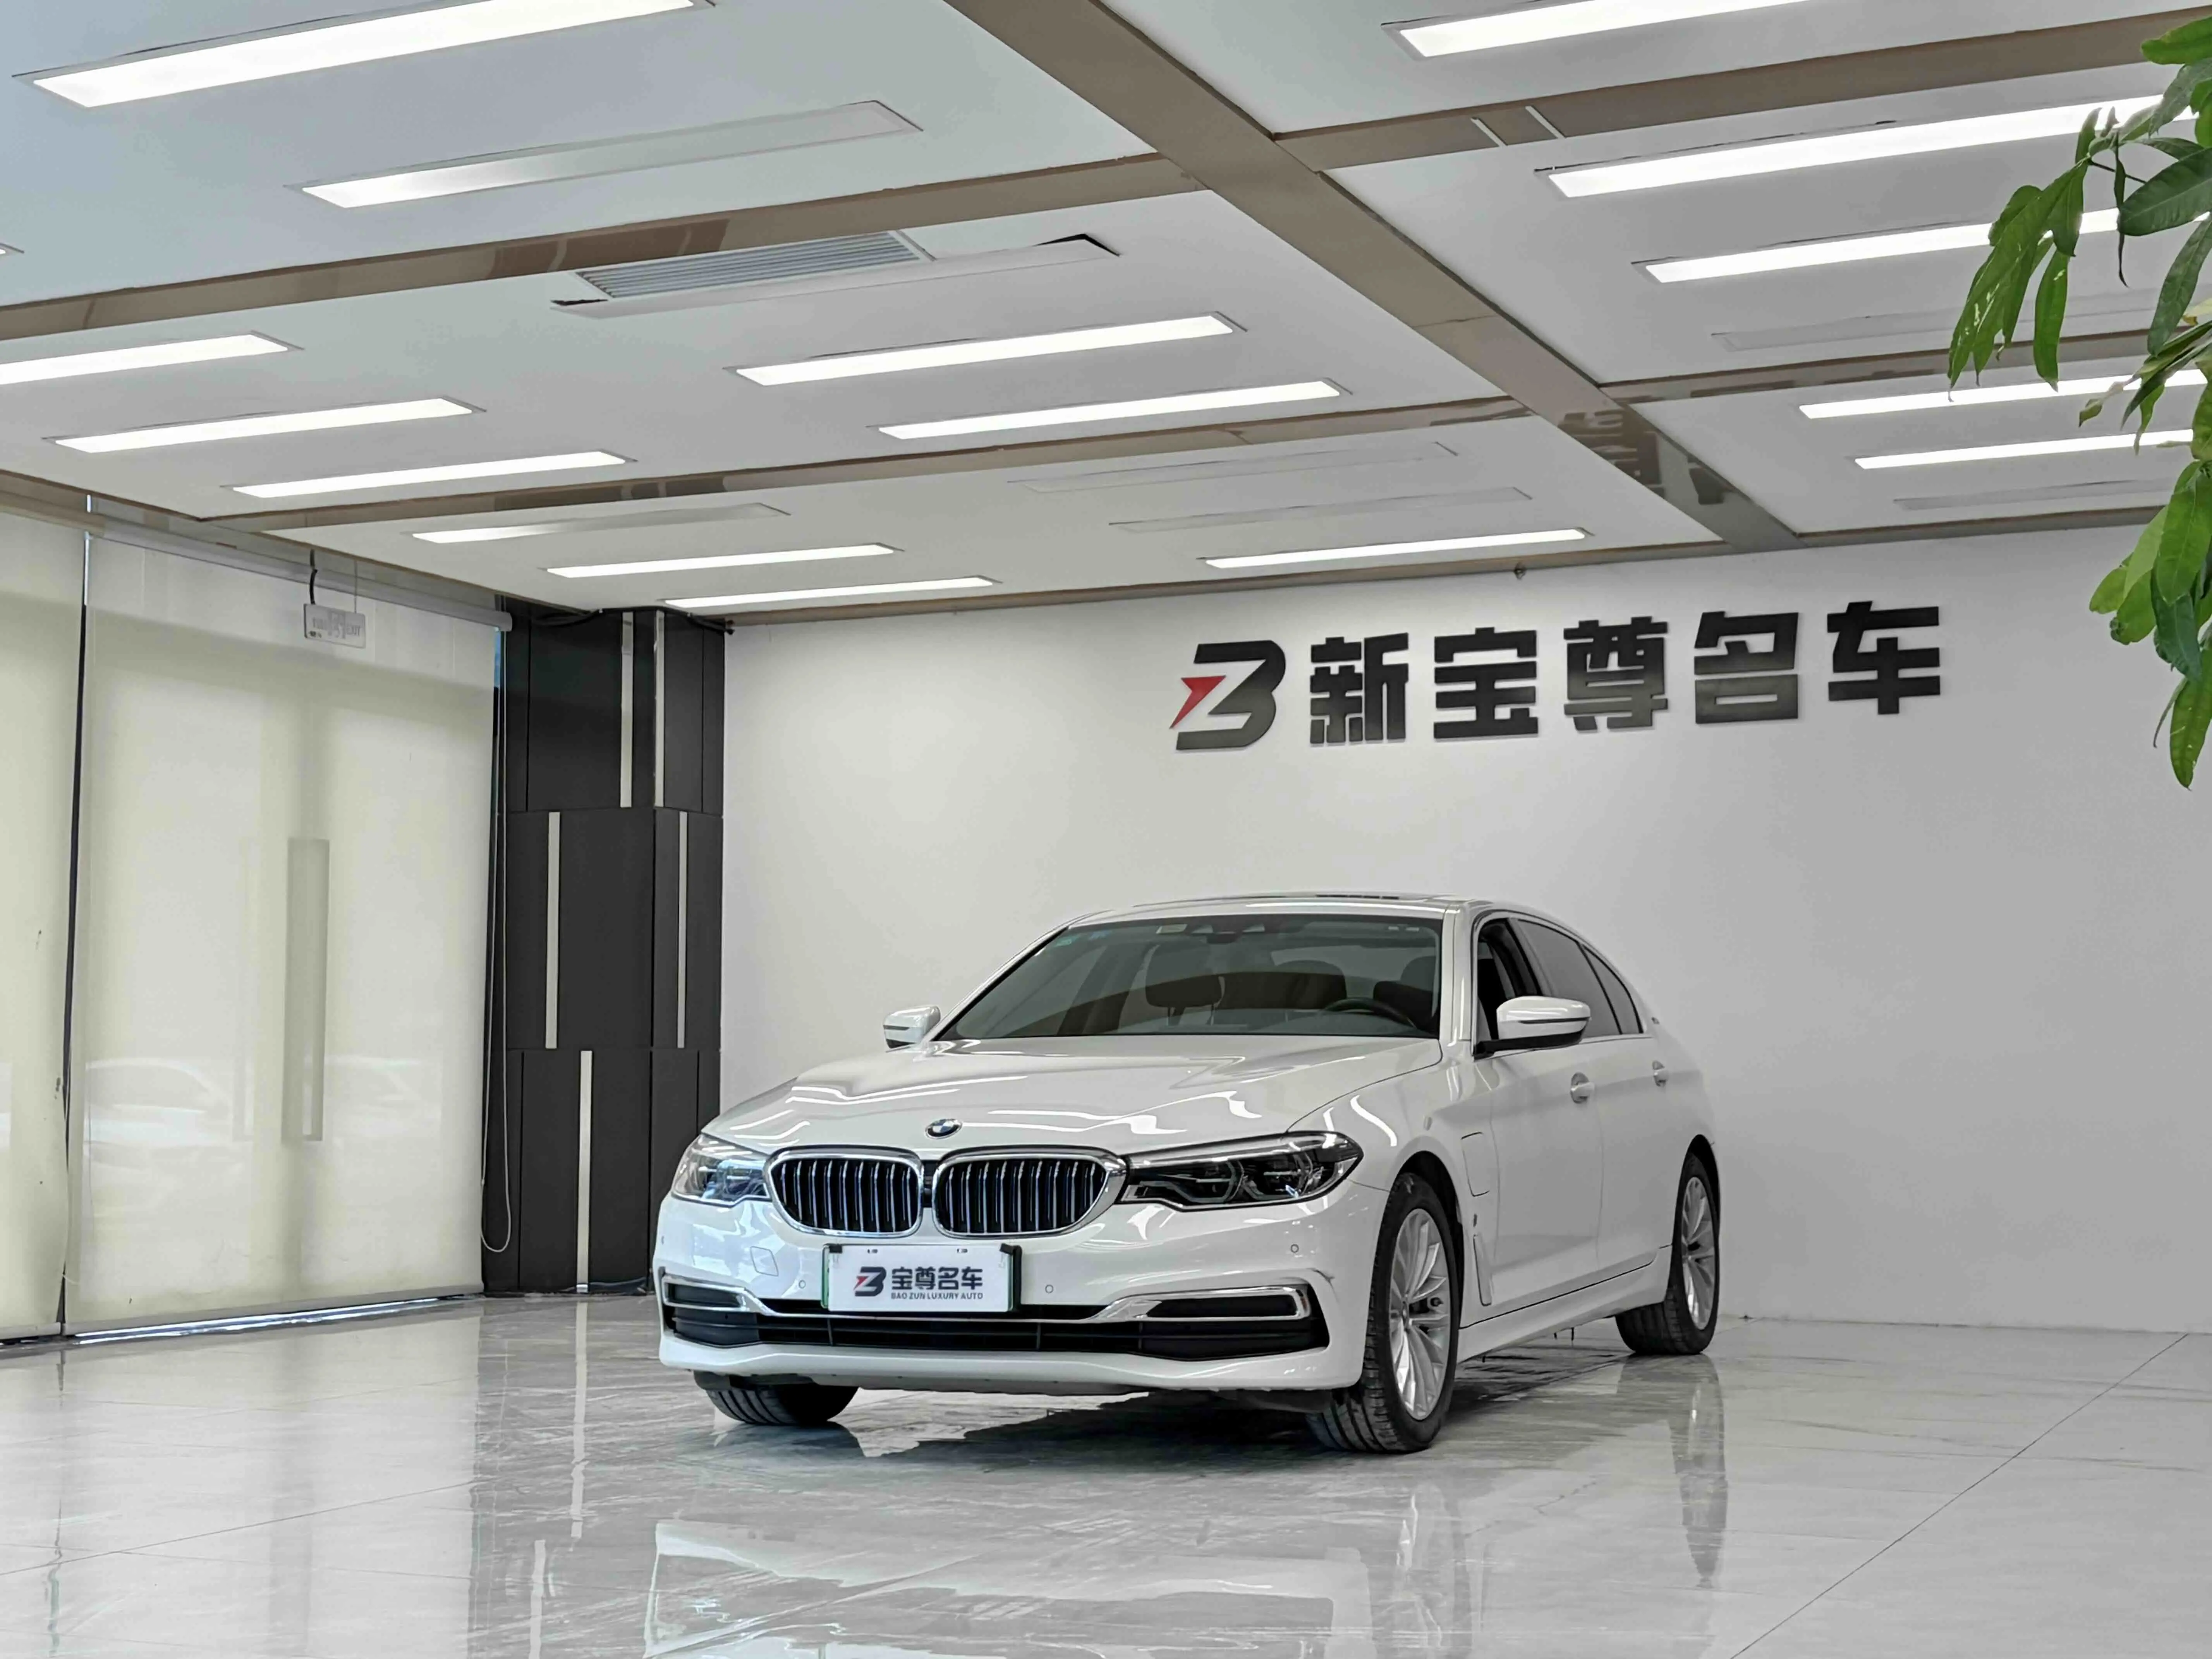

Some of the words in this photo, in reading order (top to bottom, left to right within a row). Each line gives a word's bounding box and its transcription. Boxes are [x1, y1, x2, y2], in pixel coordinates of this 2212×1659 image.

[1310, 601, 1941, 746] 新宝尊名车
[892, 1266, 982, 1290] 宝尊名车
